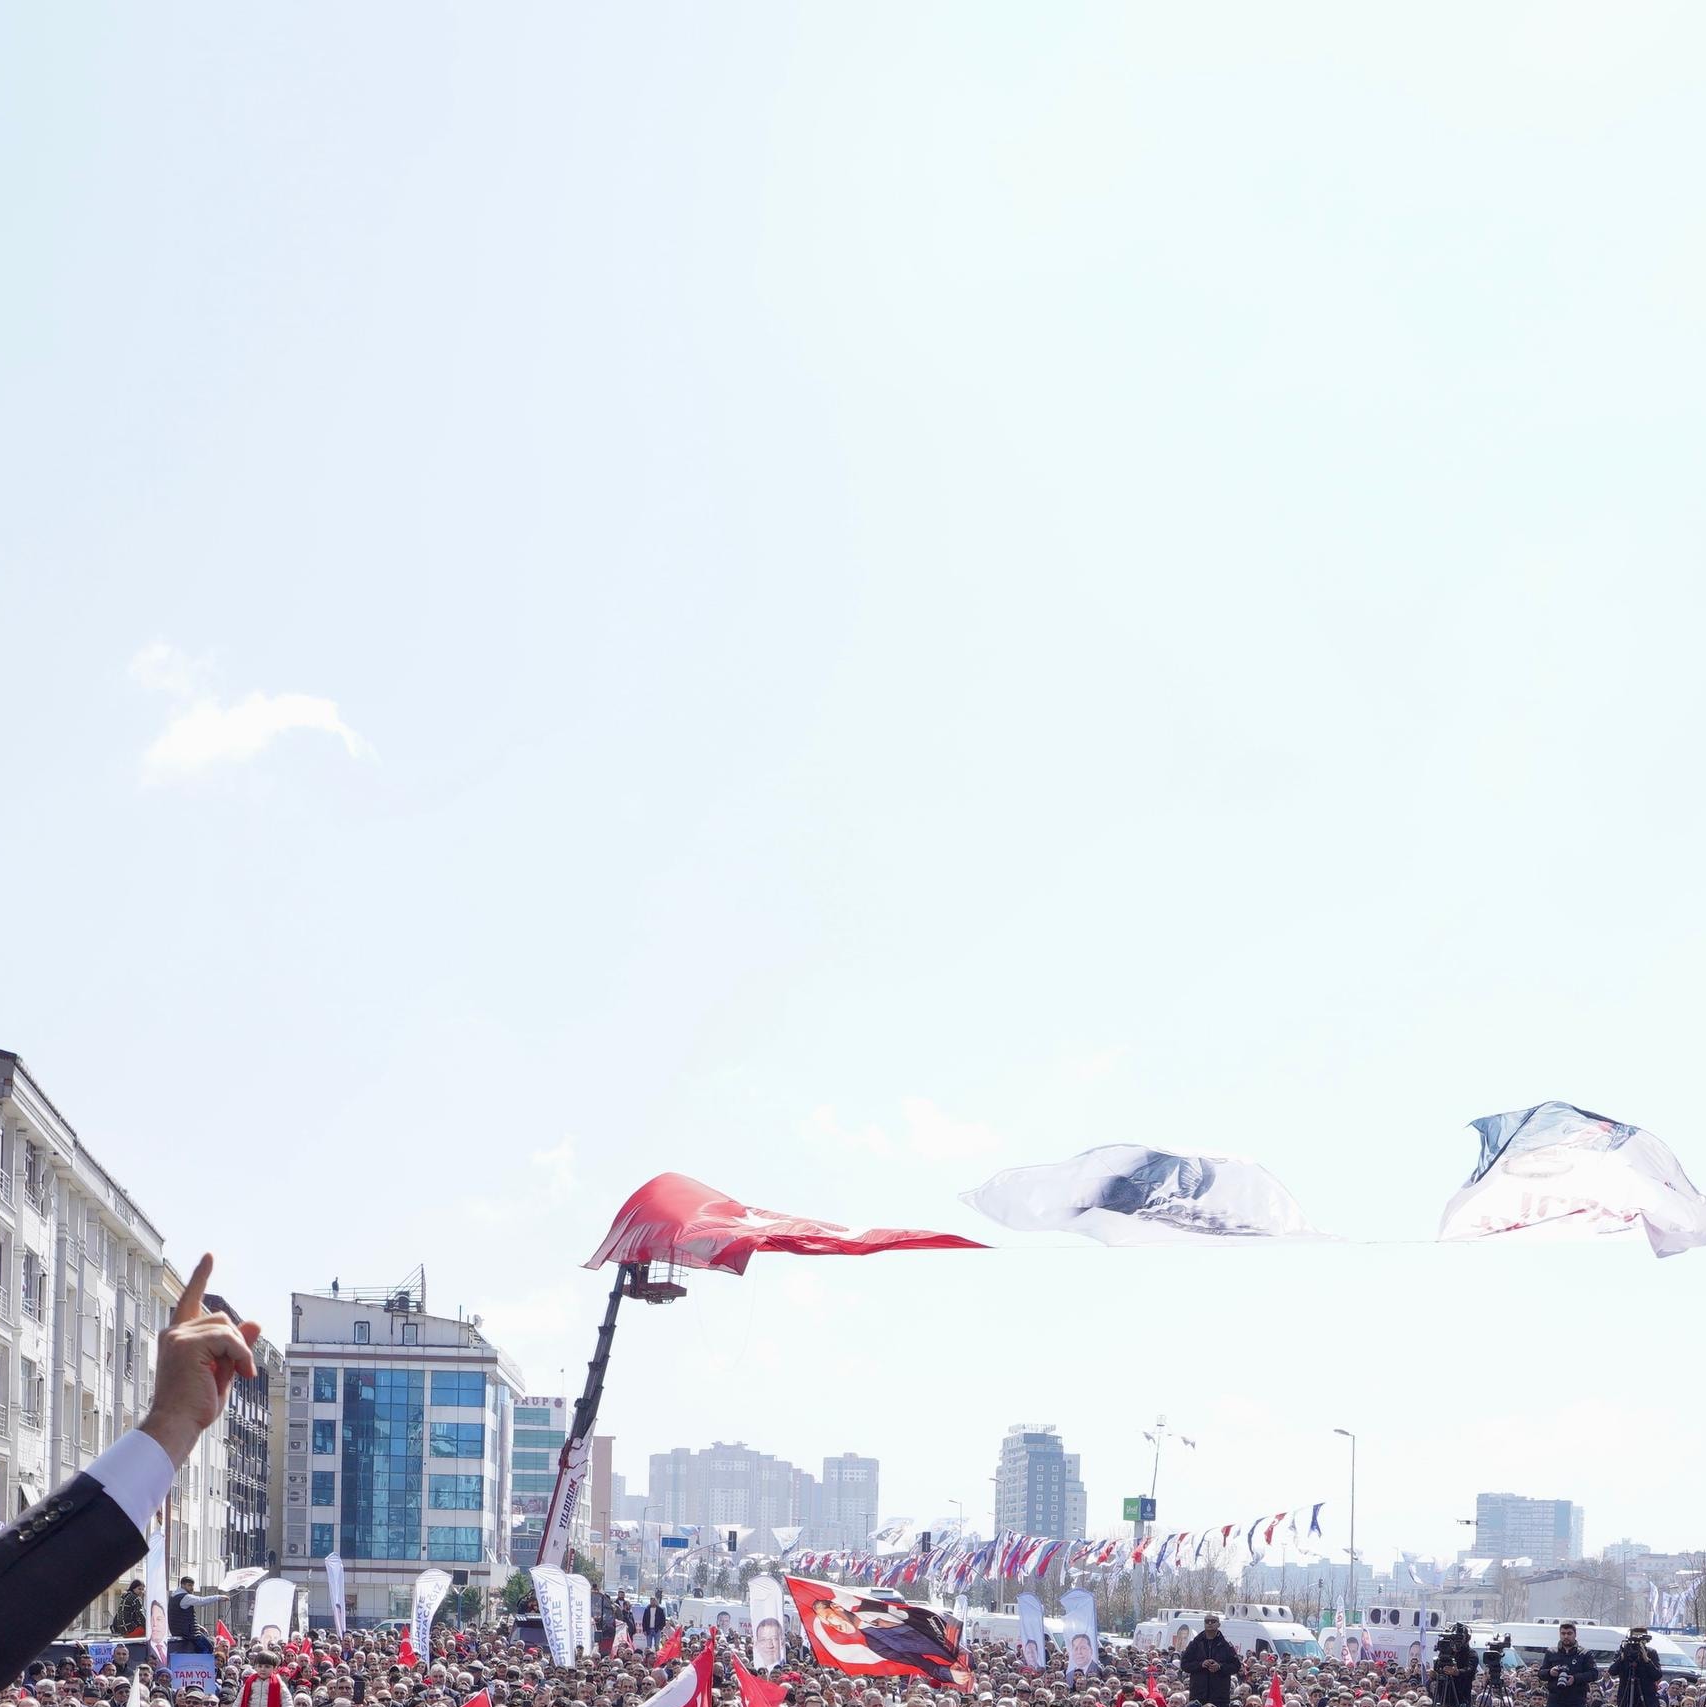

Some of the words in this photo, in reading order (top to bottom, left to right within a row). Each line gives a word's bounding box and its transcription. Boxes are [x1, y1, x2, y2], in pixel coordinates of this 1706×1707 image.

[559, 1479, 578, 1530] YILDIRIM
[1383, 1650, 1398, 1660] YOL
[174, 1671, 192, 1679] TAM
[195, 1670, 212, 1678] YOL
